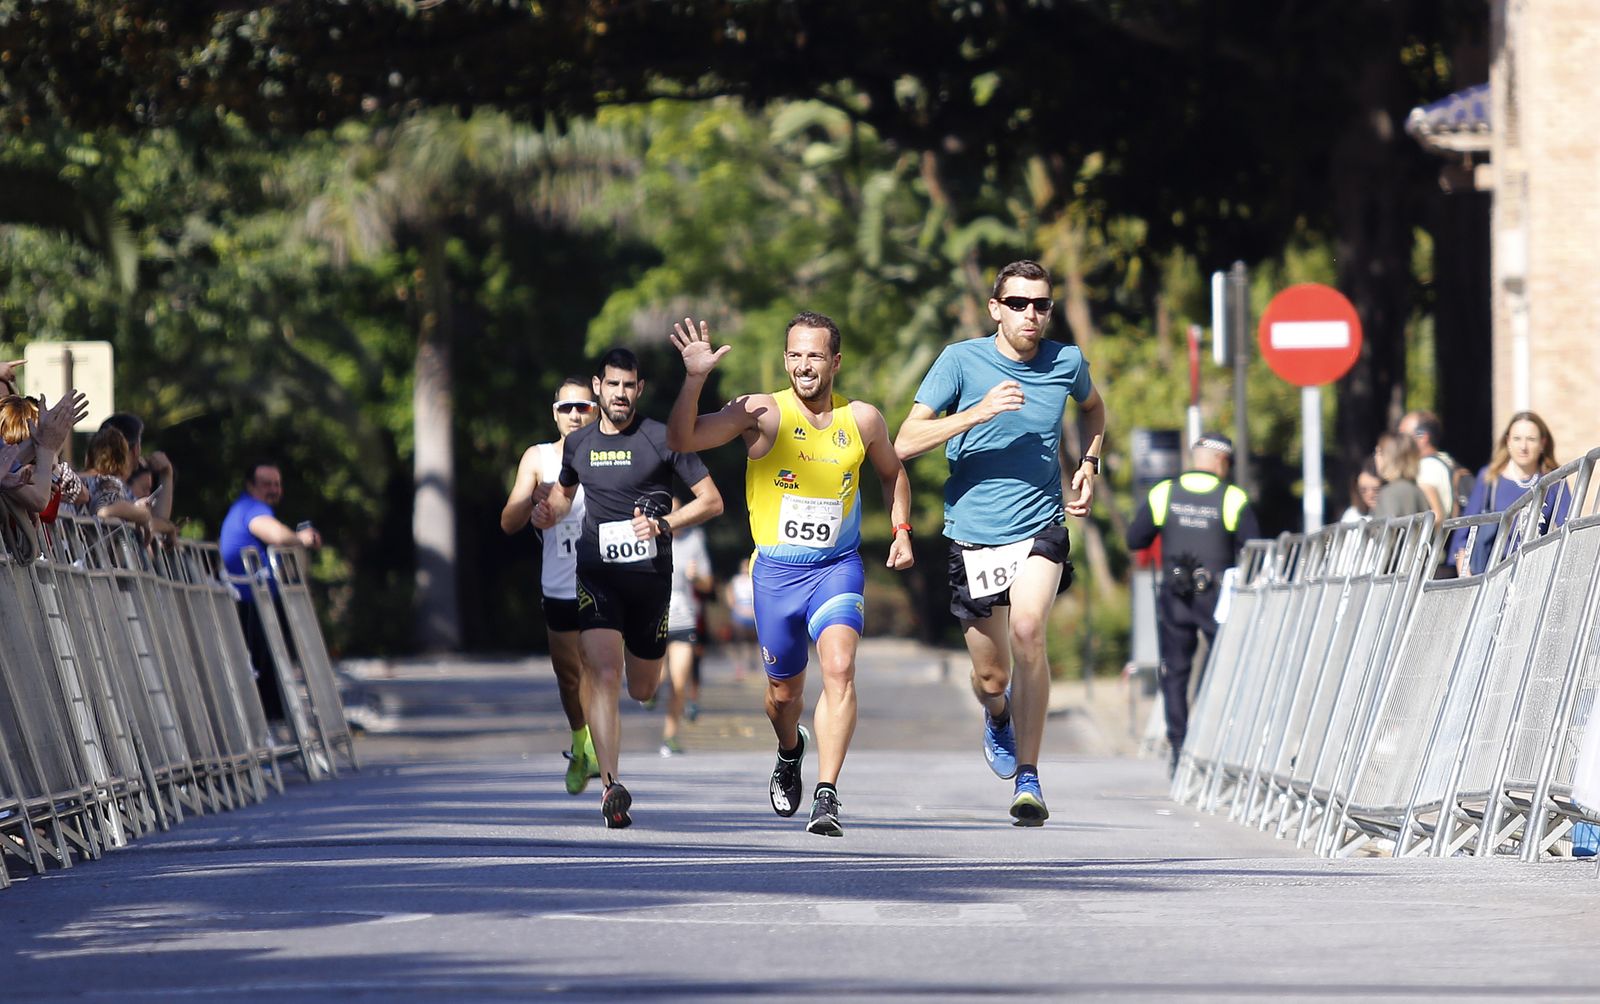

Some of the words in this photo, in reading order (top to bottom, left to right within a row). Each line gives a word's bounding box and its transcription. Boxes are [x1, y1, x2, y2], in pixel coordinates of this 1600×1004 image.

[774, 479, 799, 489] Vopak
[784, 520, 830, 541] 659
[606, 541, 647, 559] 806
